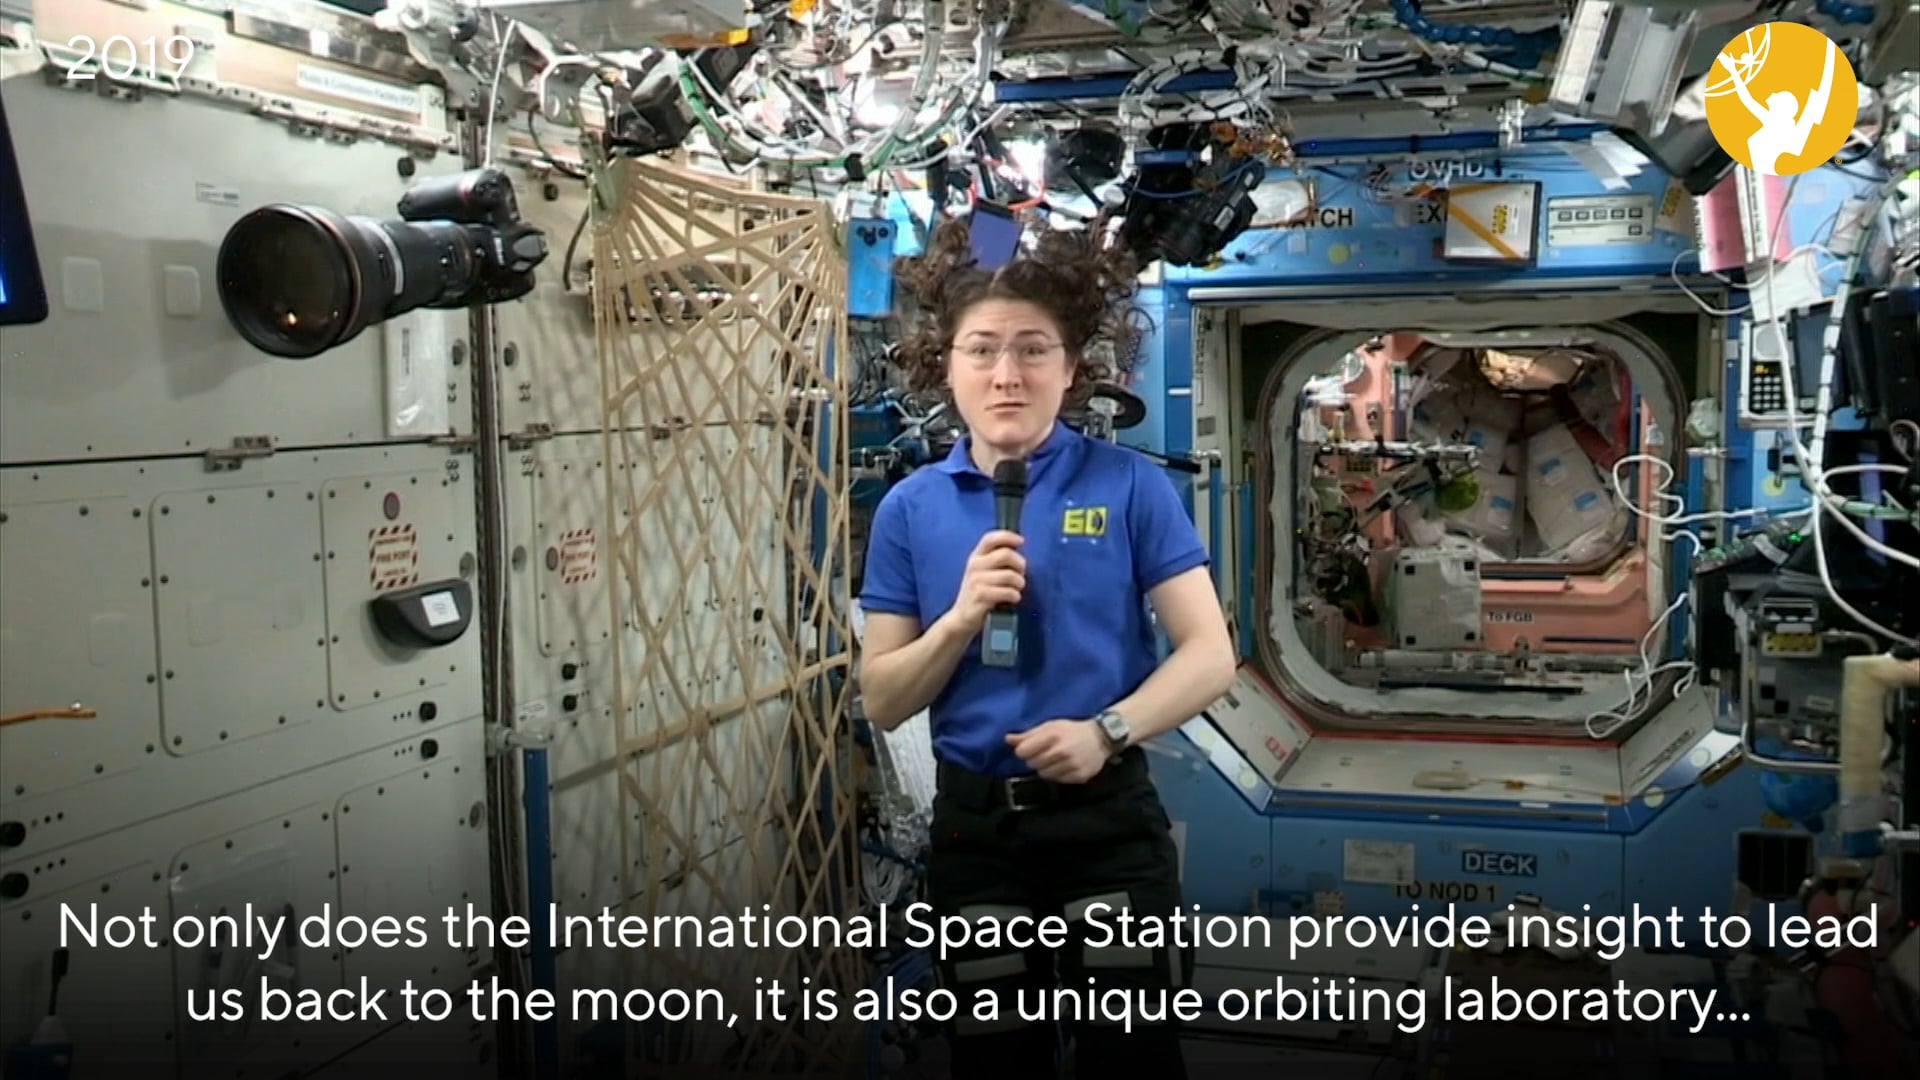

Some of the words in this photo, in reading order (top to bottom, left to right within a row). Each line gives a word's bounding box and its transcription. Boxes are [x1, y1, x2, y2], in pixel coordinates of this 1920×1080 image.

[1411, 160, 1483, 179] OVHD
[1465, 853, 1535, 875] DECK
[1430, 882, 1479, 902] NOD
[1487, 885, 1497, 903] 1
